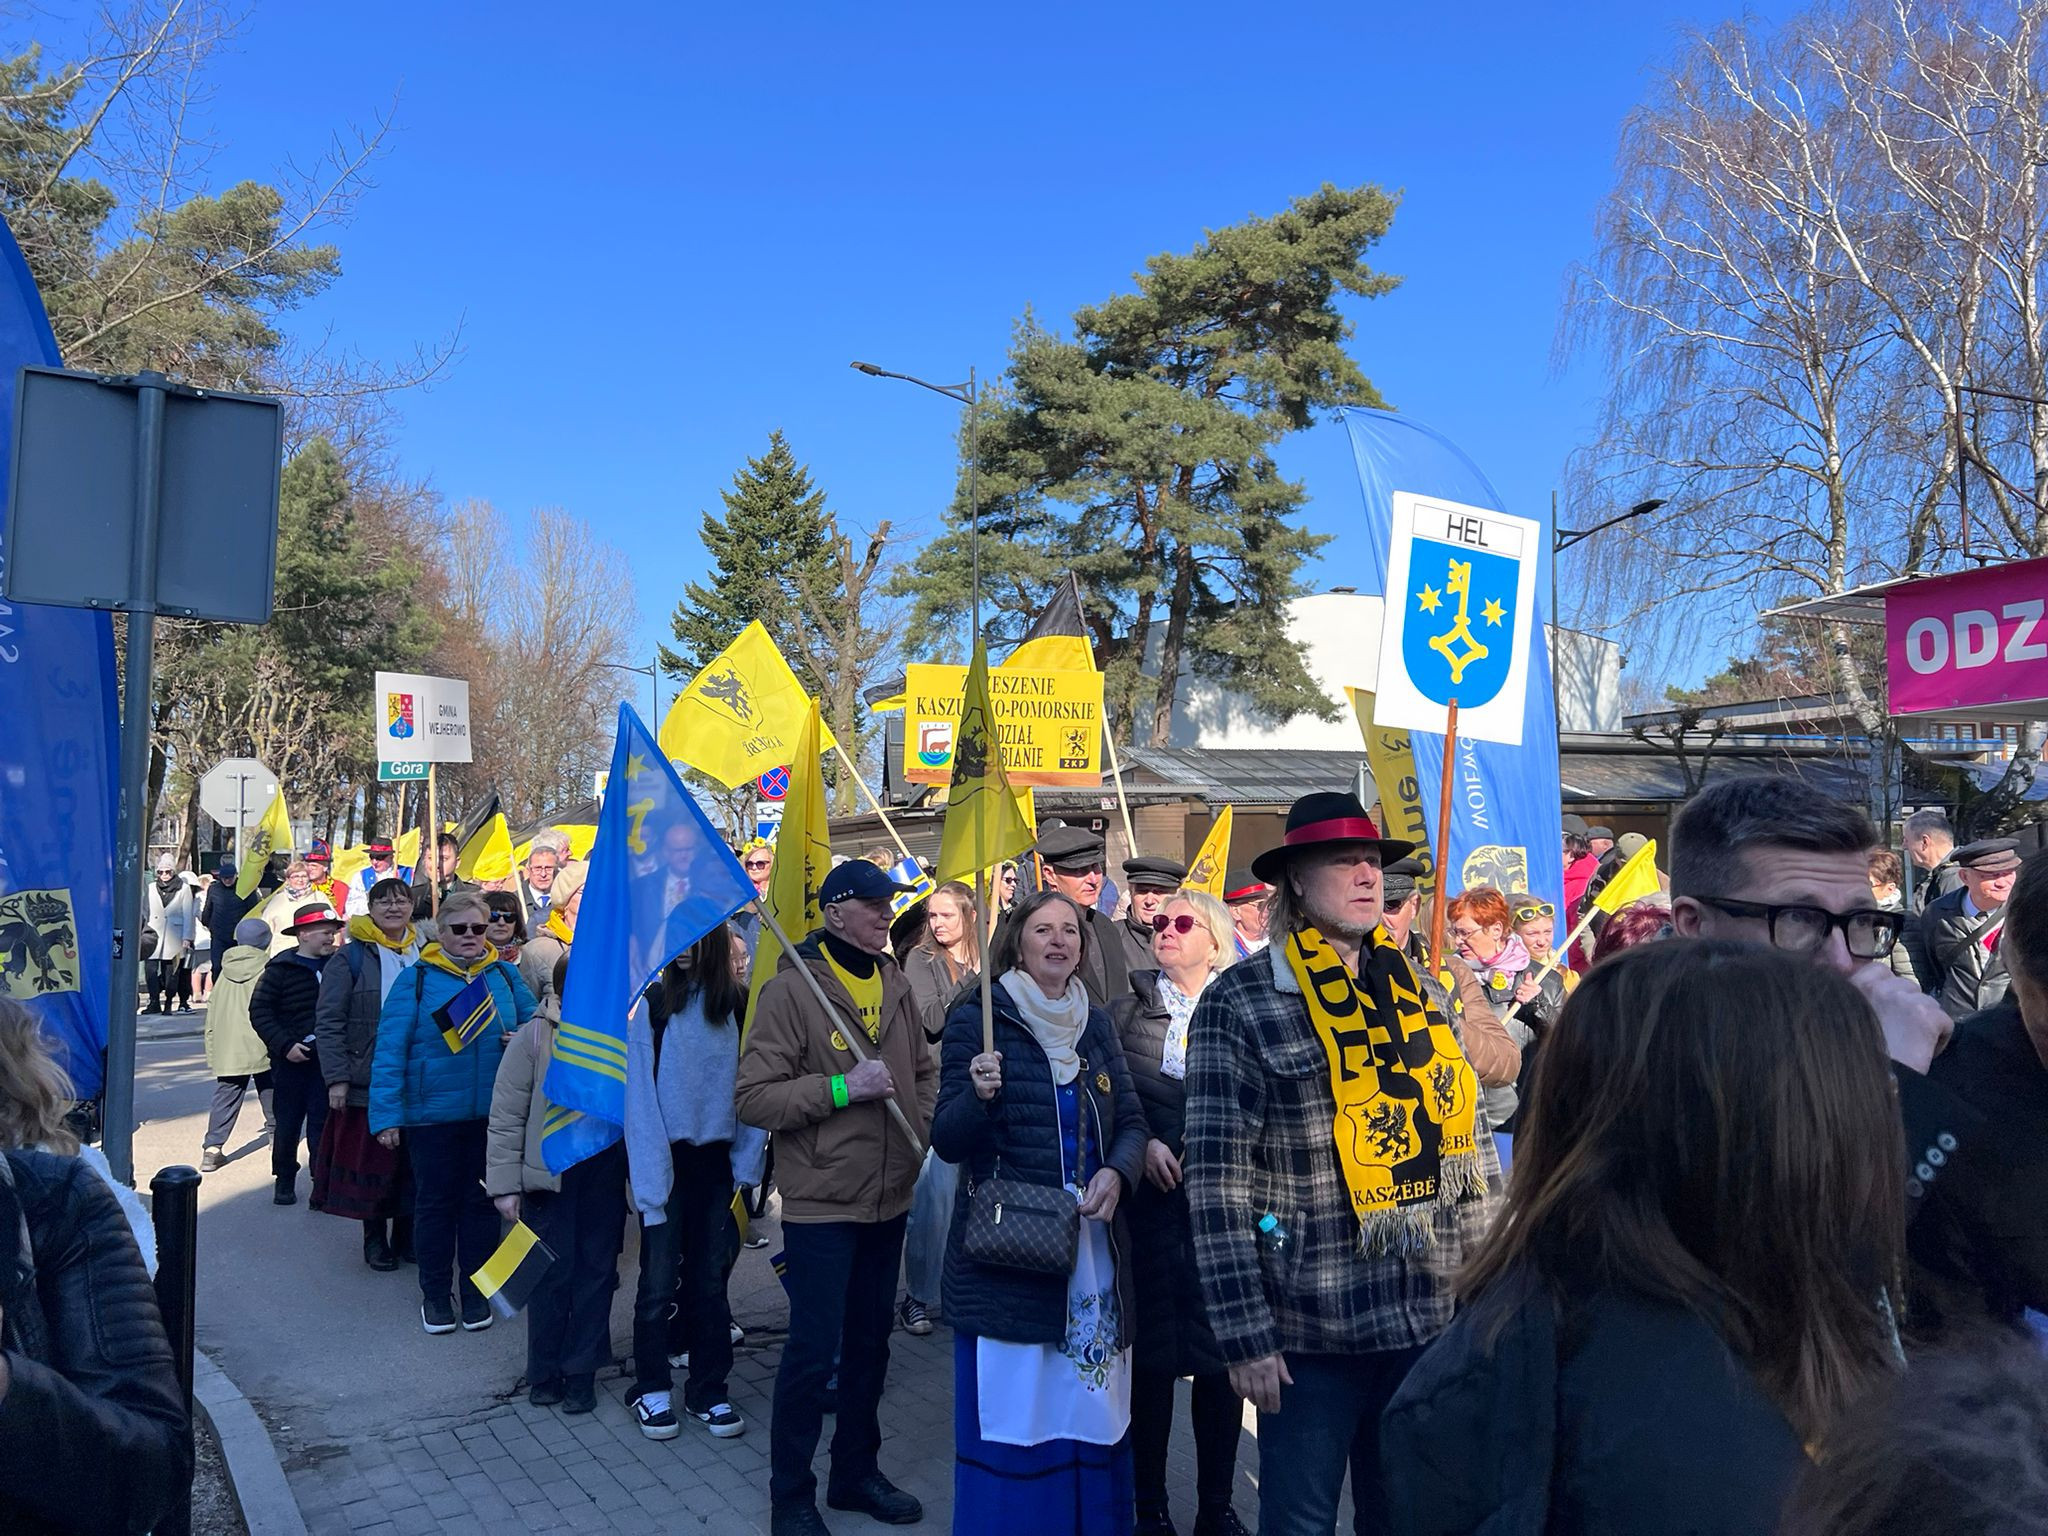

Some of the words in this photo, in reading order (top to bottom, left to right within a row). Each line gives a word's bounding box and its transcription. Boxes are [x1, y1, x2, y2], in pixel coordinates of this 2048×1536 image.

[1447, 513, 1489, 547] HEL
[1906, 598, 2047, 675] ODZ
[438, 704, 457, 718] GMINA
[428, 721, 466, 737] WEJHEROWO
[1064, 759, 1085, 768] ZKP
[1353, 1175, 1436, 1206] KASZËBË
